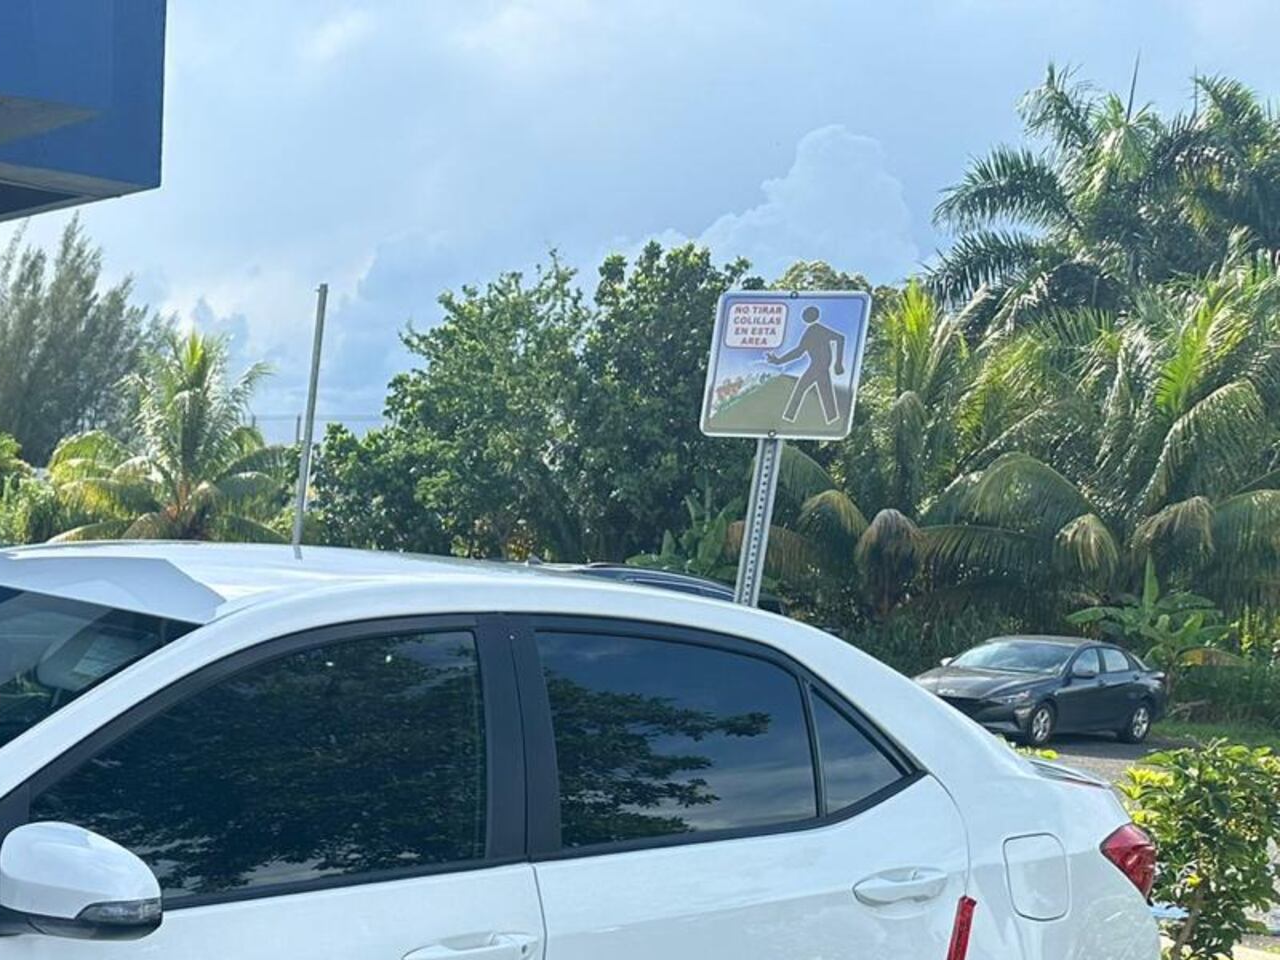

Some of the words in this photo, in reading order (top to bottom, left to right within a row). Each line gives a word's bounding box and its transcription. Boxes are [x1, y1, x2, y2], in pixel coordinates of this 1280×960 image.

[734, 306, 750, 314] NO
[752, 306, 782, 314] TIRAR
[734, 316, 781, 325] COLILLAS
[734, 327, 748, 335] EN
[751, 327, 777, 335] ESTA
[741, 337, 768, 345] AREA
